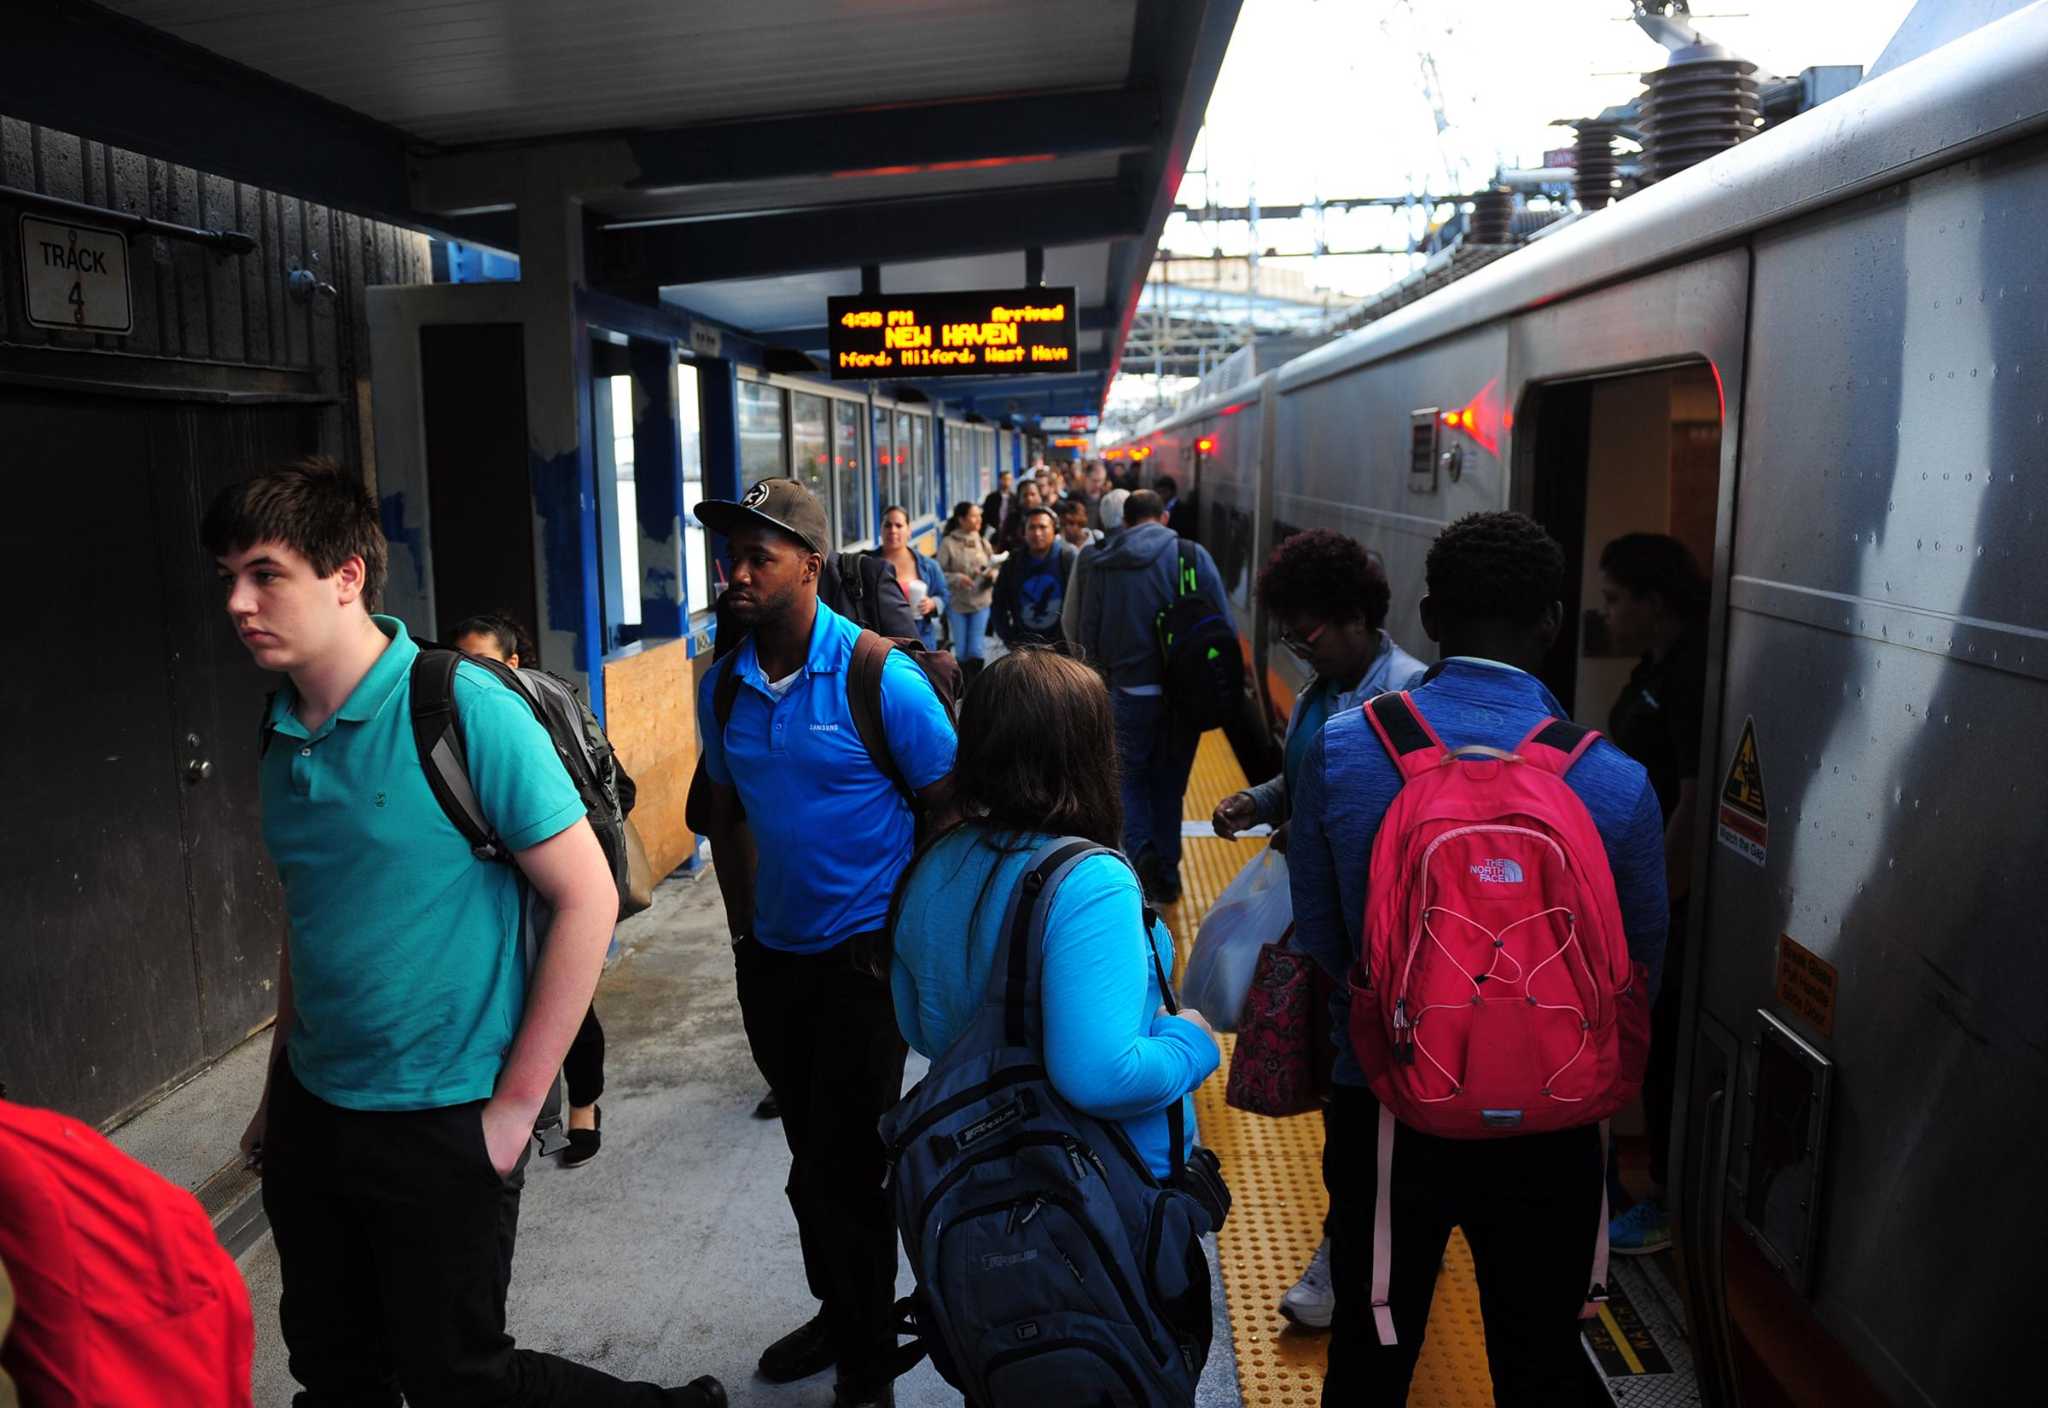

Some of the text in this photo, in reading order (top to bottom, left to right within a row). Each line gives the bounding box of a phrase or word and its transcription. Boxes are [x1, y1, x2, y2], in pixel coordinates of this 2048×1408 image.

[39, 241, 107, 275] TRACK
[68, 281, 84, 310] 4
[887, 310, 914, 327] PM
[991, 304, 1064, 323] Arrived
[885, 322, 1018, 349] NEW HAVEN
[901, 347, 976, 366] Milford,
[985, 346, 1025, 362] West
[809, 723, 839, 731] SAMSUNG
[1470, 865, 1505, 874] NORTH
[1479, 874, 1505, 882] FACE
